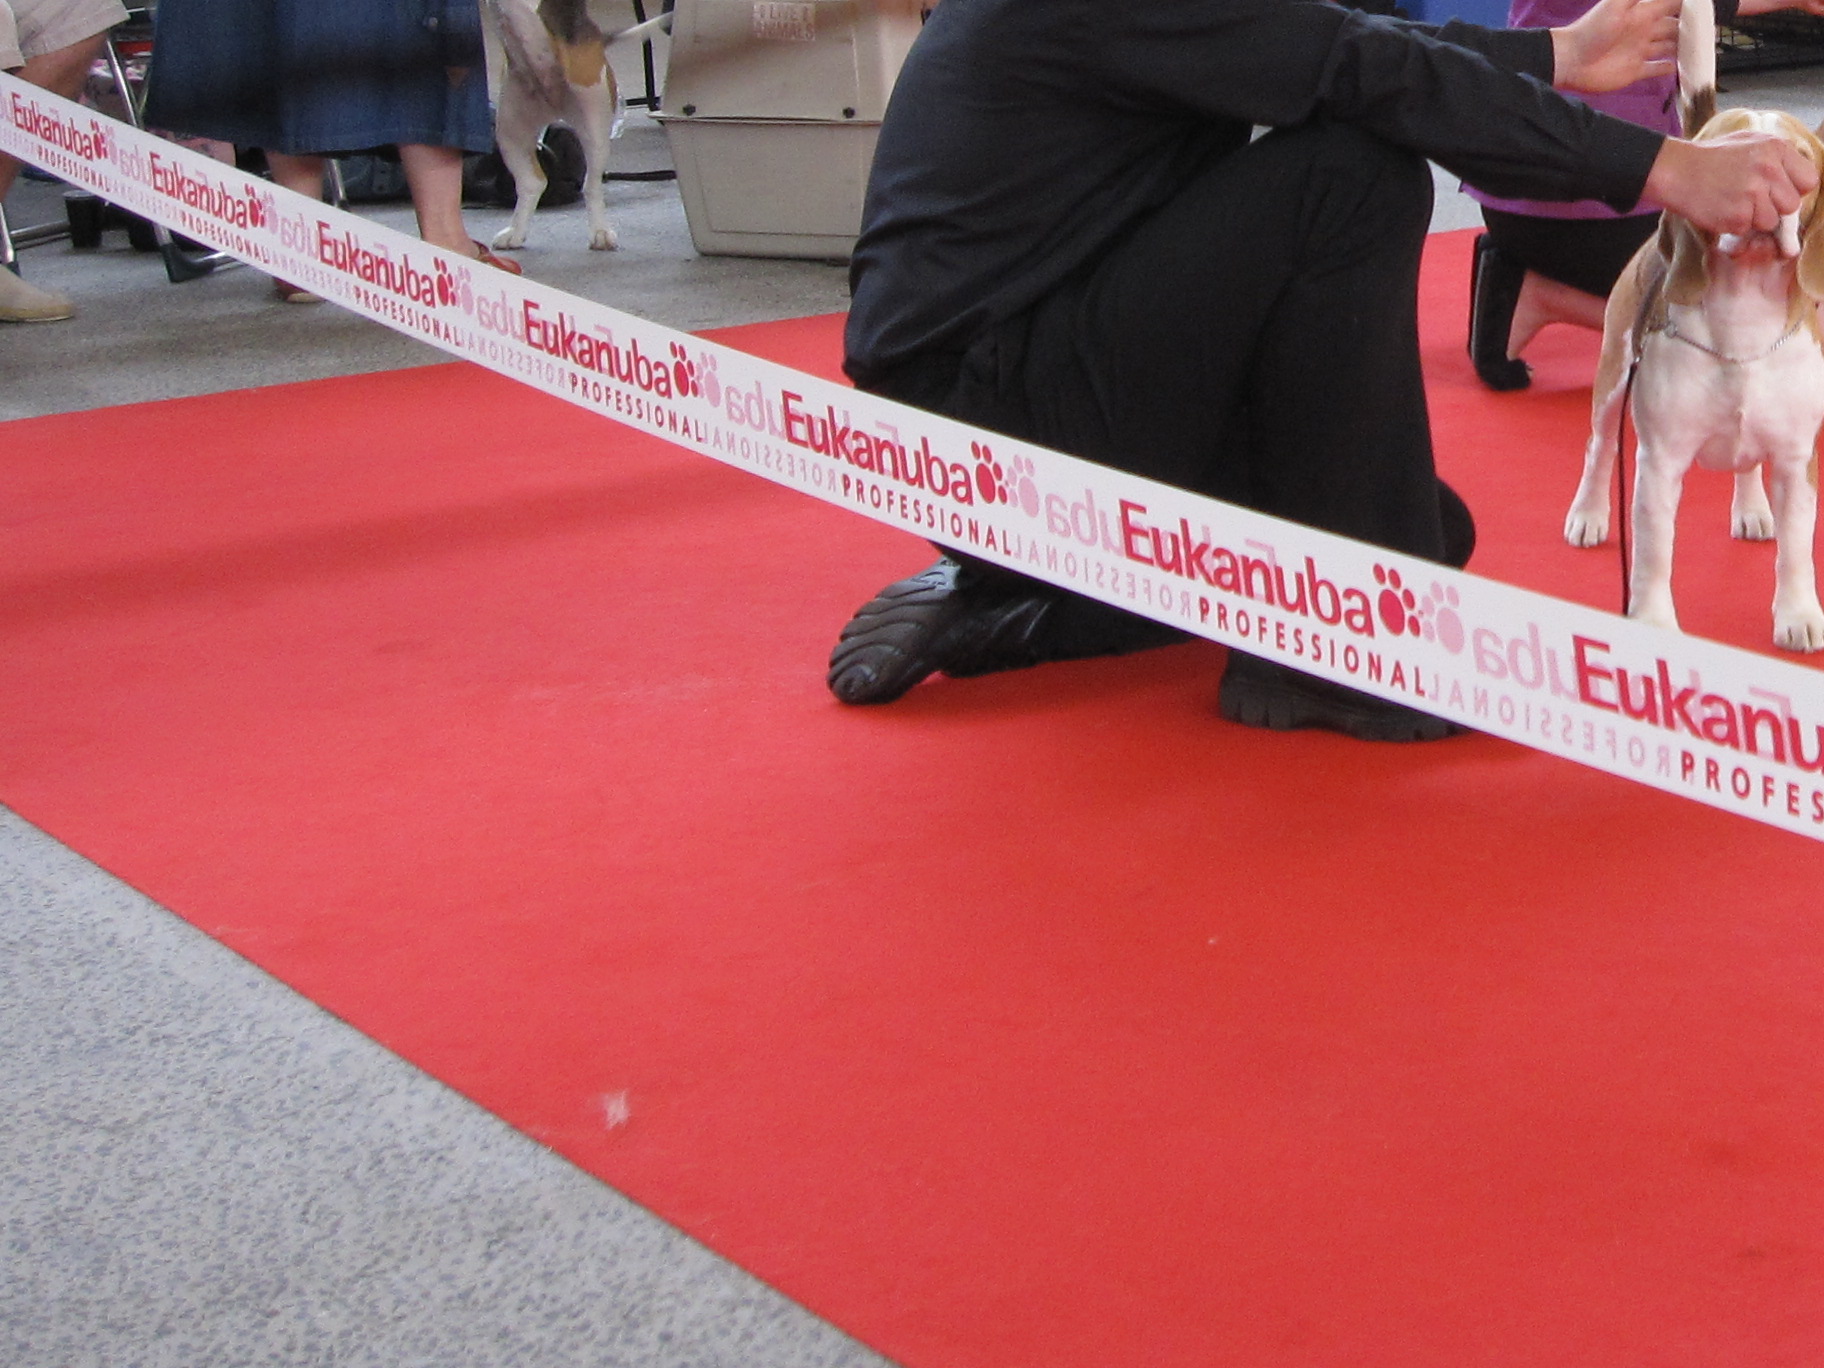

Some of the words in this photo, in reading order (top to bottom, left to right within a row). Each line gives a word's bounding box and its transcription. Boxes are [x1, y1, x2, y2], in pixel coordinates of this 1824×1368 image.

[12, 92, 95, 161] Eukanuba
[37, 145, 112, 193] PROFESSIONAL
[149, 151, 248, 226] Eukanuba
[180, 210, 270, 264] PROFESSIONAL
[315, 220, 437, 308] Eukanuba
[352, 286, 462, 346] PROFESSIONAL
[521, 299, 673, 398] Eukanuba
[569, 375, 704, 443] PROFESSIONAL
[780, 388, 974, 506] Eukanuba
[841, 472, 1012, 556] PROFESSIONAL
[1117, 498, 1375, 637] Eukanuba
[1198, 595, 1427, 697] PROFESSIONAL
